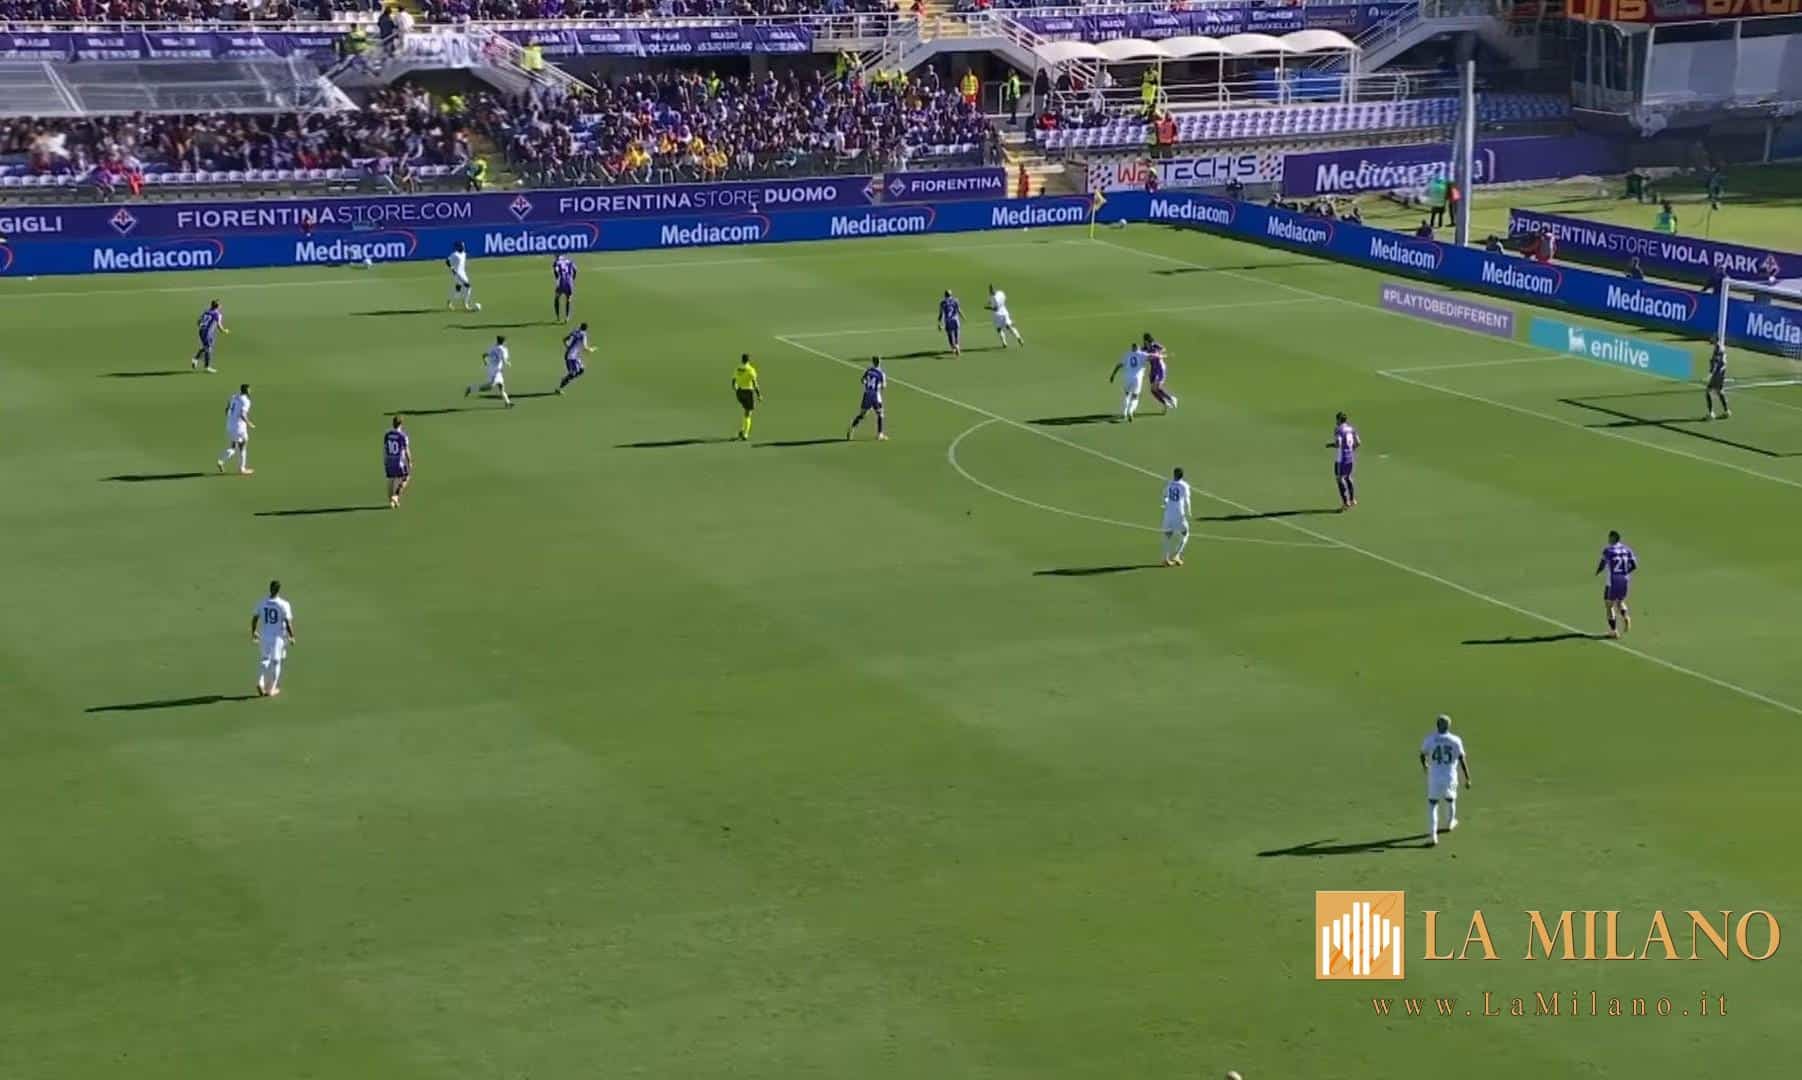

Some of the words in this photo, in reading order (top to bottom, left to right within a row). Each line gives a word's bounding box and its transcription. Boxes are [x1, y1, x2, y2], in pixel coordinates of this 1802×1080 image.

[763, 186, 838, 203] DUOMO
[911, 176, 1002, 193] FIORENTINA
[176, 202, 473, 228] FIORENTINASTORE.COM
[991, 206, 1084, 226] Mediacom
[1149, 199, 1230, 225] Mediacom
[0, 215, 63, 234] GIGLI
[661, 224, 761, 245] Mediacom
[830, 214, 925, 236] Mediacom
[1266, 215, 1328, 243] Mediacom
[482, 232, 589, 254] Mediacom
[1370, 236, 1437, 269] Mediacom
[92, 246, 214, 270] Mediacom
[1660, 242, 1709, 266] VIOLA
[1713, 250, 1758, 274] PARK
[1482, 260, 1554, 296] Mediacom
[1383, 287, 1511, 329] #PLAYTOBEDIFFERENT
[1606, 284, 1687, 322] Mediacom
[1590, 339, 1651, 369] enilive
[388, 440, 399, 454] 10
[1613, 556, 1629, 573] 21
[263, 607, 279, 625] 19
